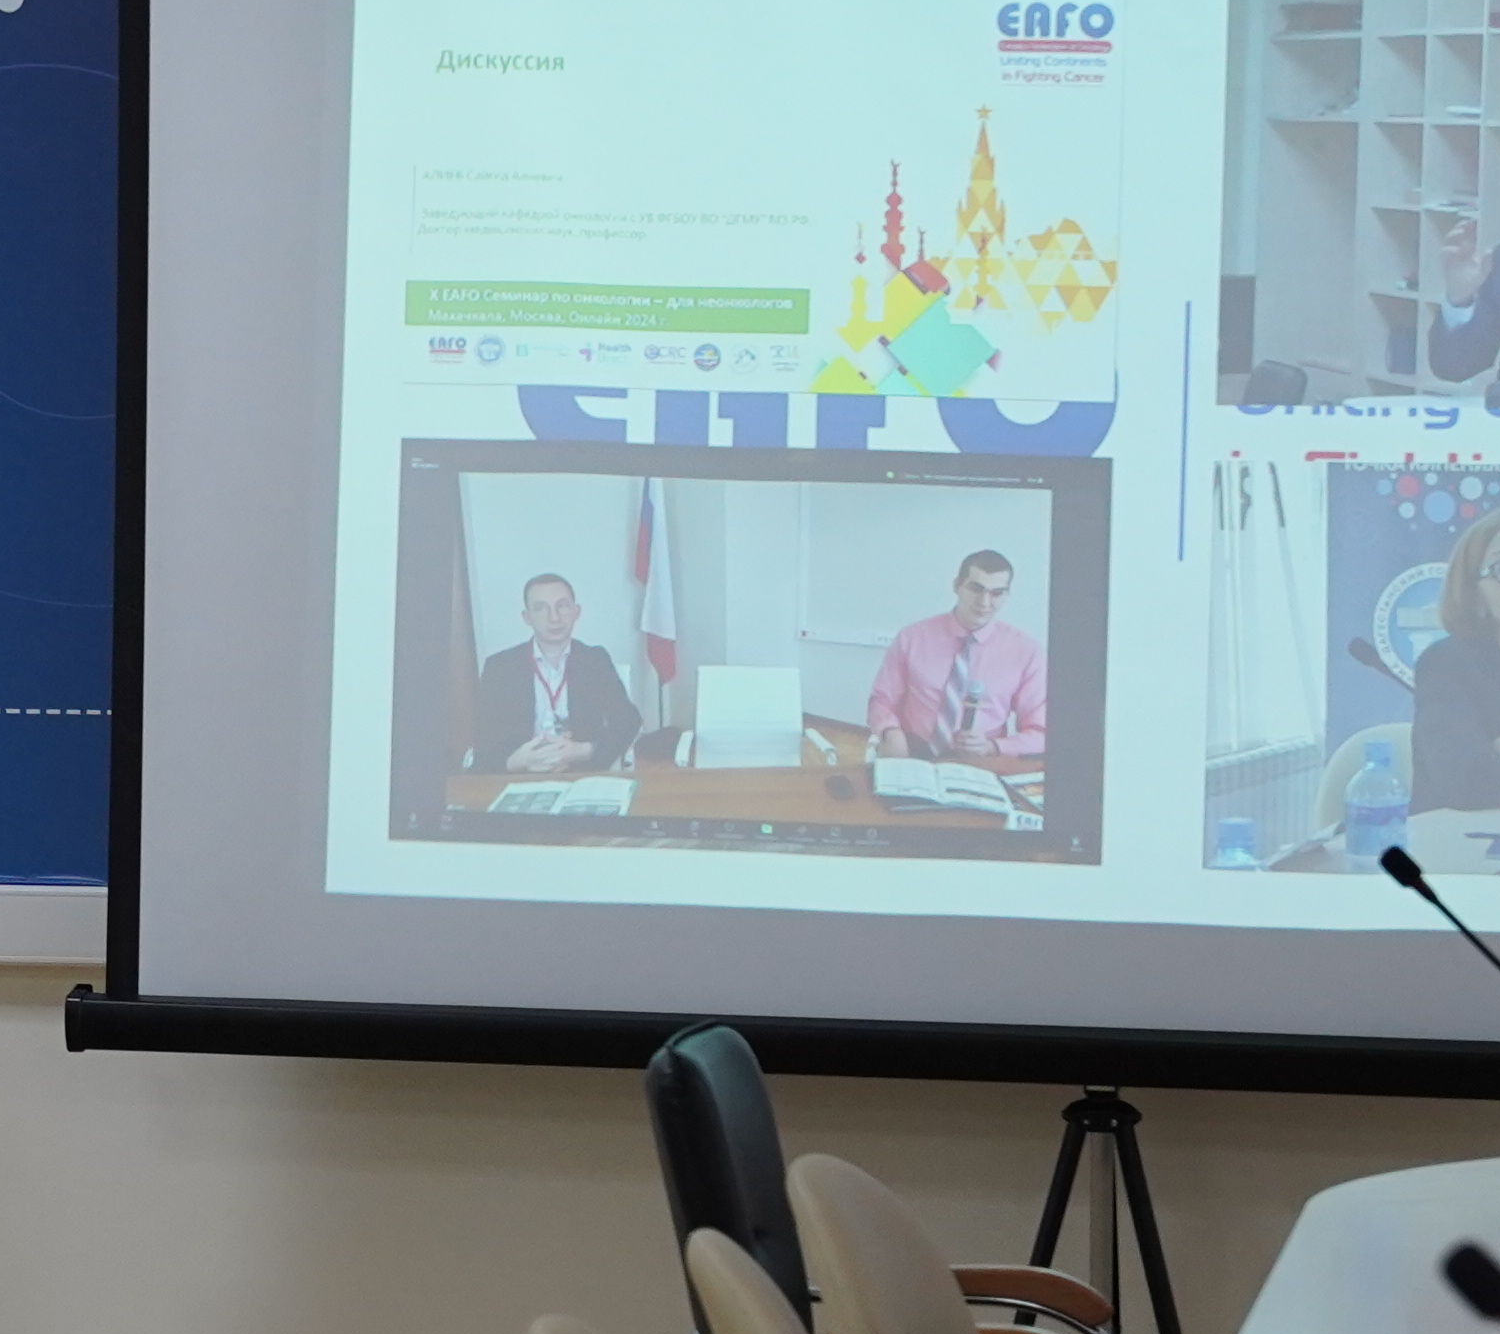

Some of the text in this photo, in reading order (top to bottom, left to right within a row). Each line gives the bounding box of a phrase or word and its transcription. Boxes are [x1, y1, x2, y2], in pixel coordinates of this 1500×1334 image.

[997, 2, 1114, 38] EAFO
[436, 49, 564, 74] Дискуссия
[1001, 56, 1106, 67] Uniting Continents
[1015, 71, 1061, 83] Fighting
[1064, 71, 1105, 82] Cancer
[429, 289, 439, 301] X
[443, 289, 480, 302] EAFO
[483, 289, 549, 304] Семинар
[552, 293, 571, 303] по
[573, 294, 651, 306] онкологии
[666, 298, 695, 310] для
[699, 298, 794, 310] неонкологов
[625, 314, 657, 326] 2024
